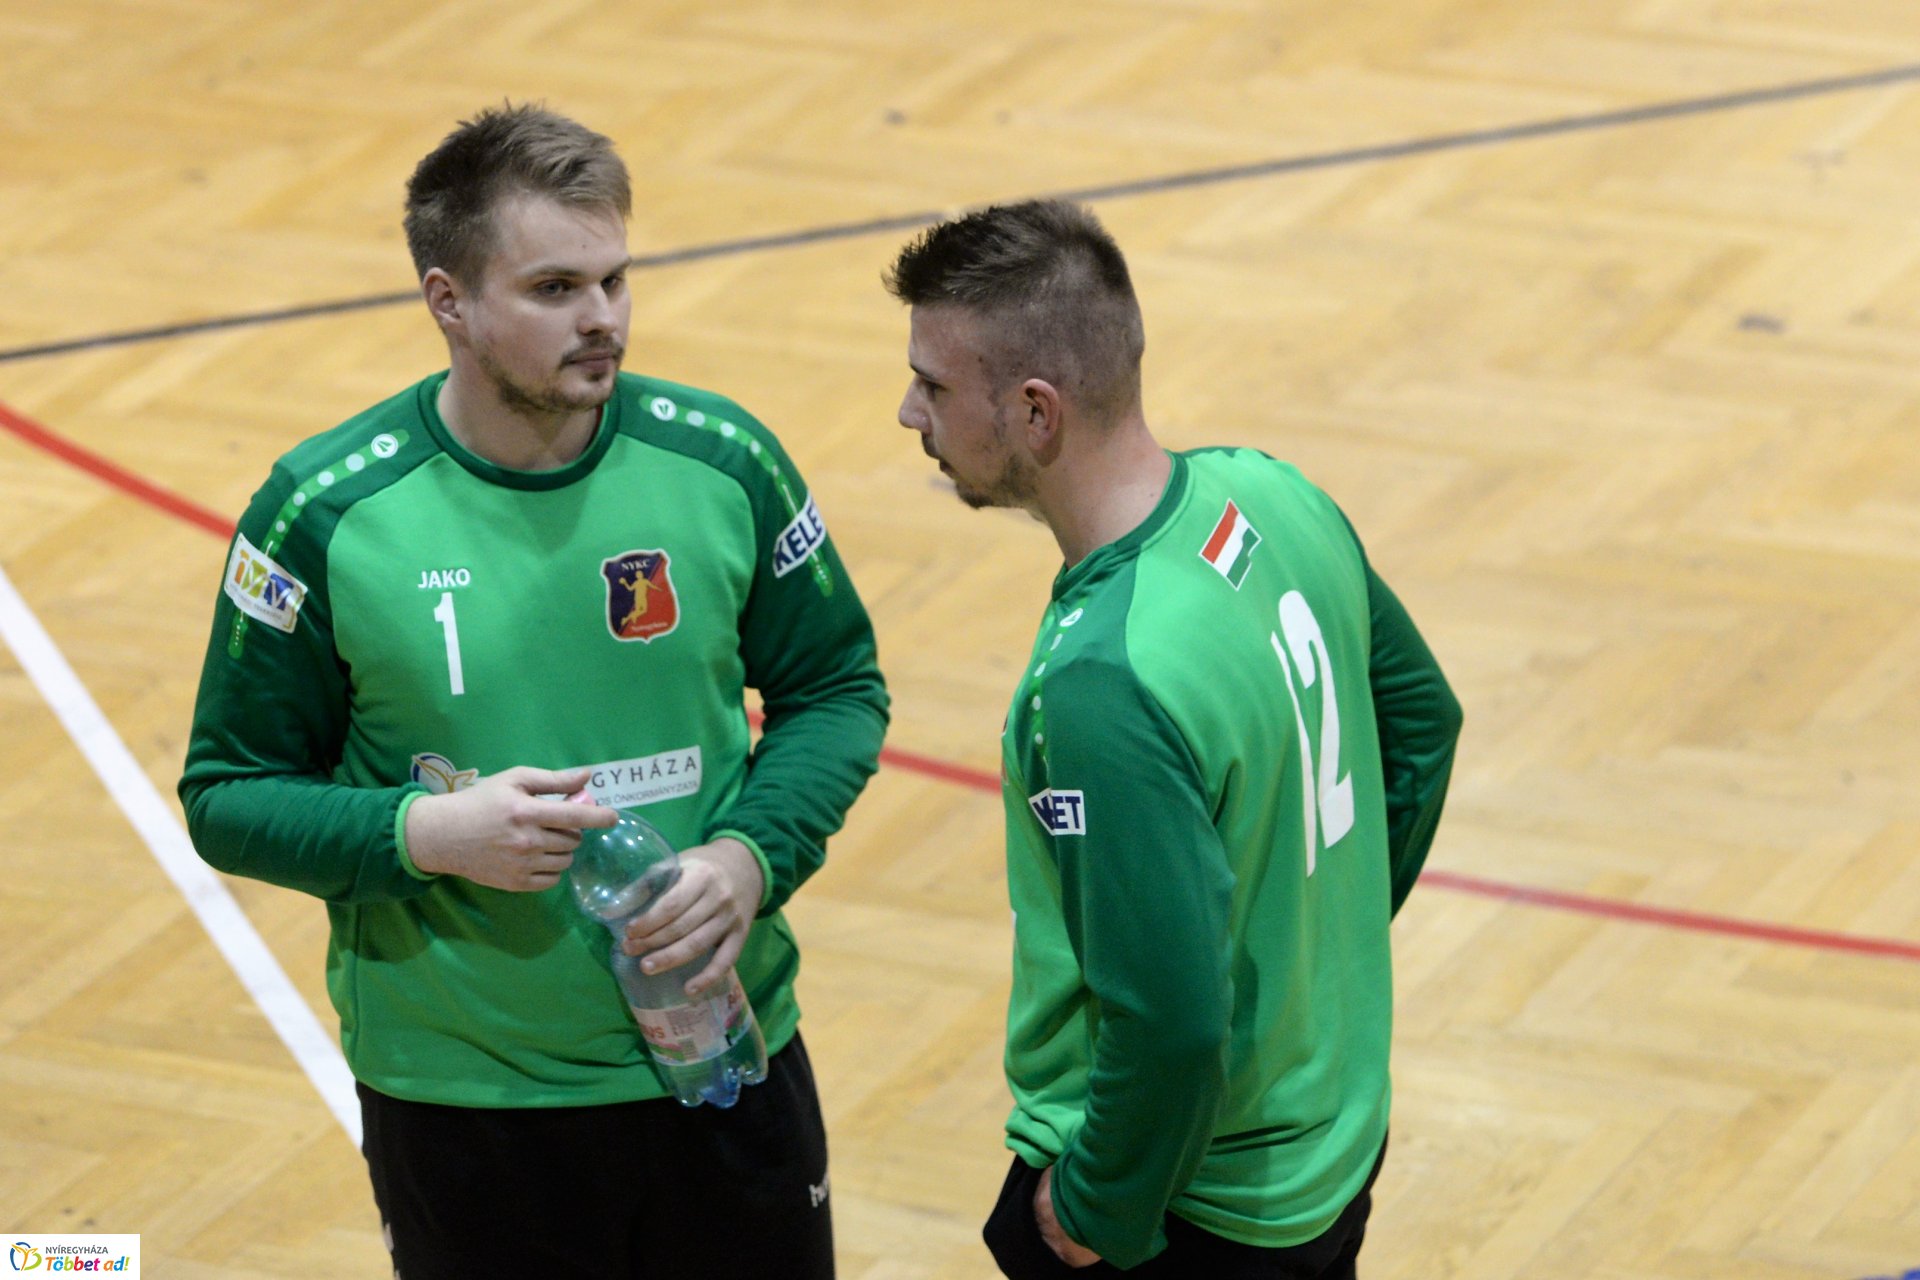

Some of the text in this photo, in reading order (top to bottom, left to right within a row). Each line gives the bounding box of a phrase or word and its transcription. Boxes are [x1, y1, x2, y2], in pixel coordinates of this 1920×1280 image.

[775, 501, 823, 571] KELE
[418, 568, 471, 589] JAKO
[433, 591, 464, 695] 1
[1270, 590, 1354, 878] 12
[591, 755, 697, 788] GYHÁZA
